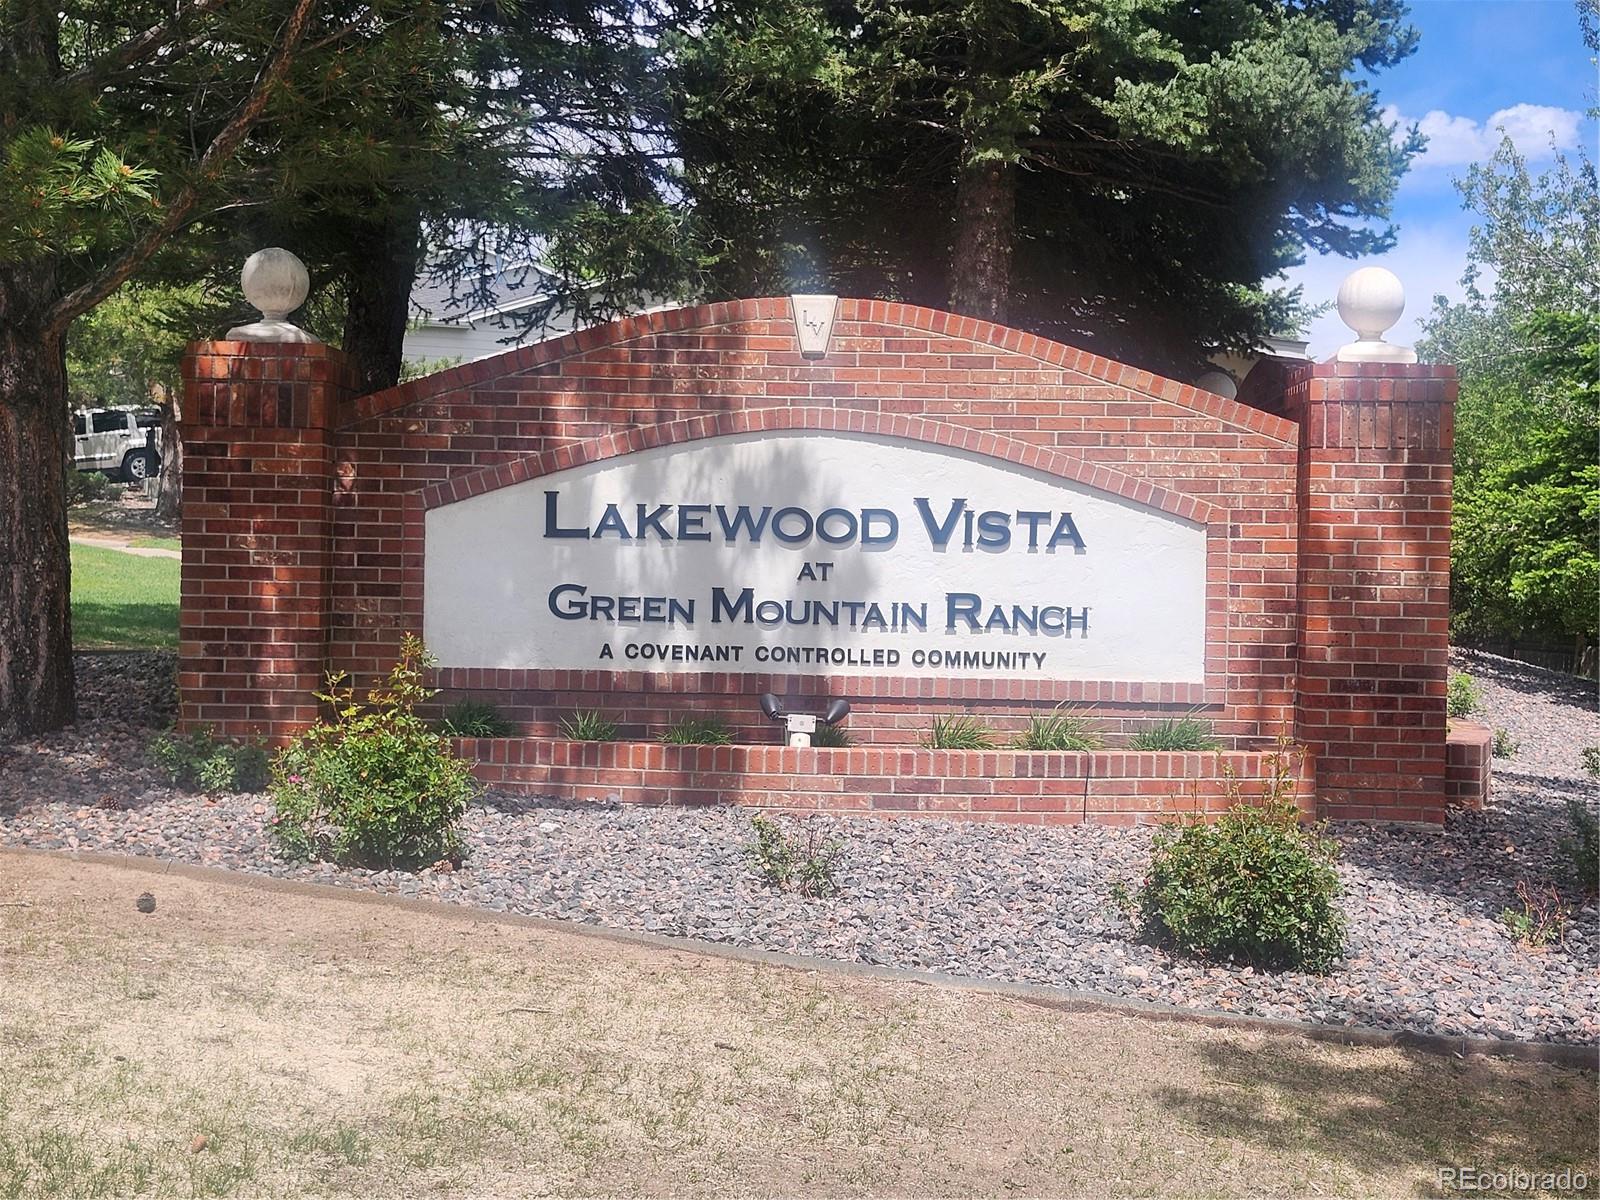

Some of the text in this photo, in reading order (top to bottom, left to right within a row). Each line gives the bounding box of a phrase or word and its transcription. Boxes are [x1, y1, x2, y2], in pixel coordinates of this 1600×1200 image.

[543, 490, 1087, 549] LAKEWOOD VISTA
[797, 562, 834, 582] AT
[548, 583, 1089, 632] GREEN MOUNTAIN RANCH
[599, 643, 1047, 670] A COVENANT CONTROLLED COMMUNITY
